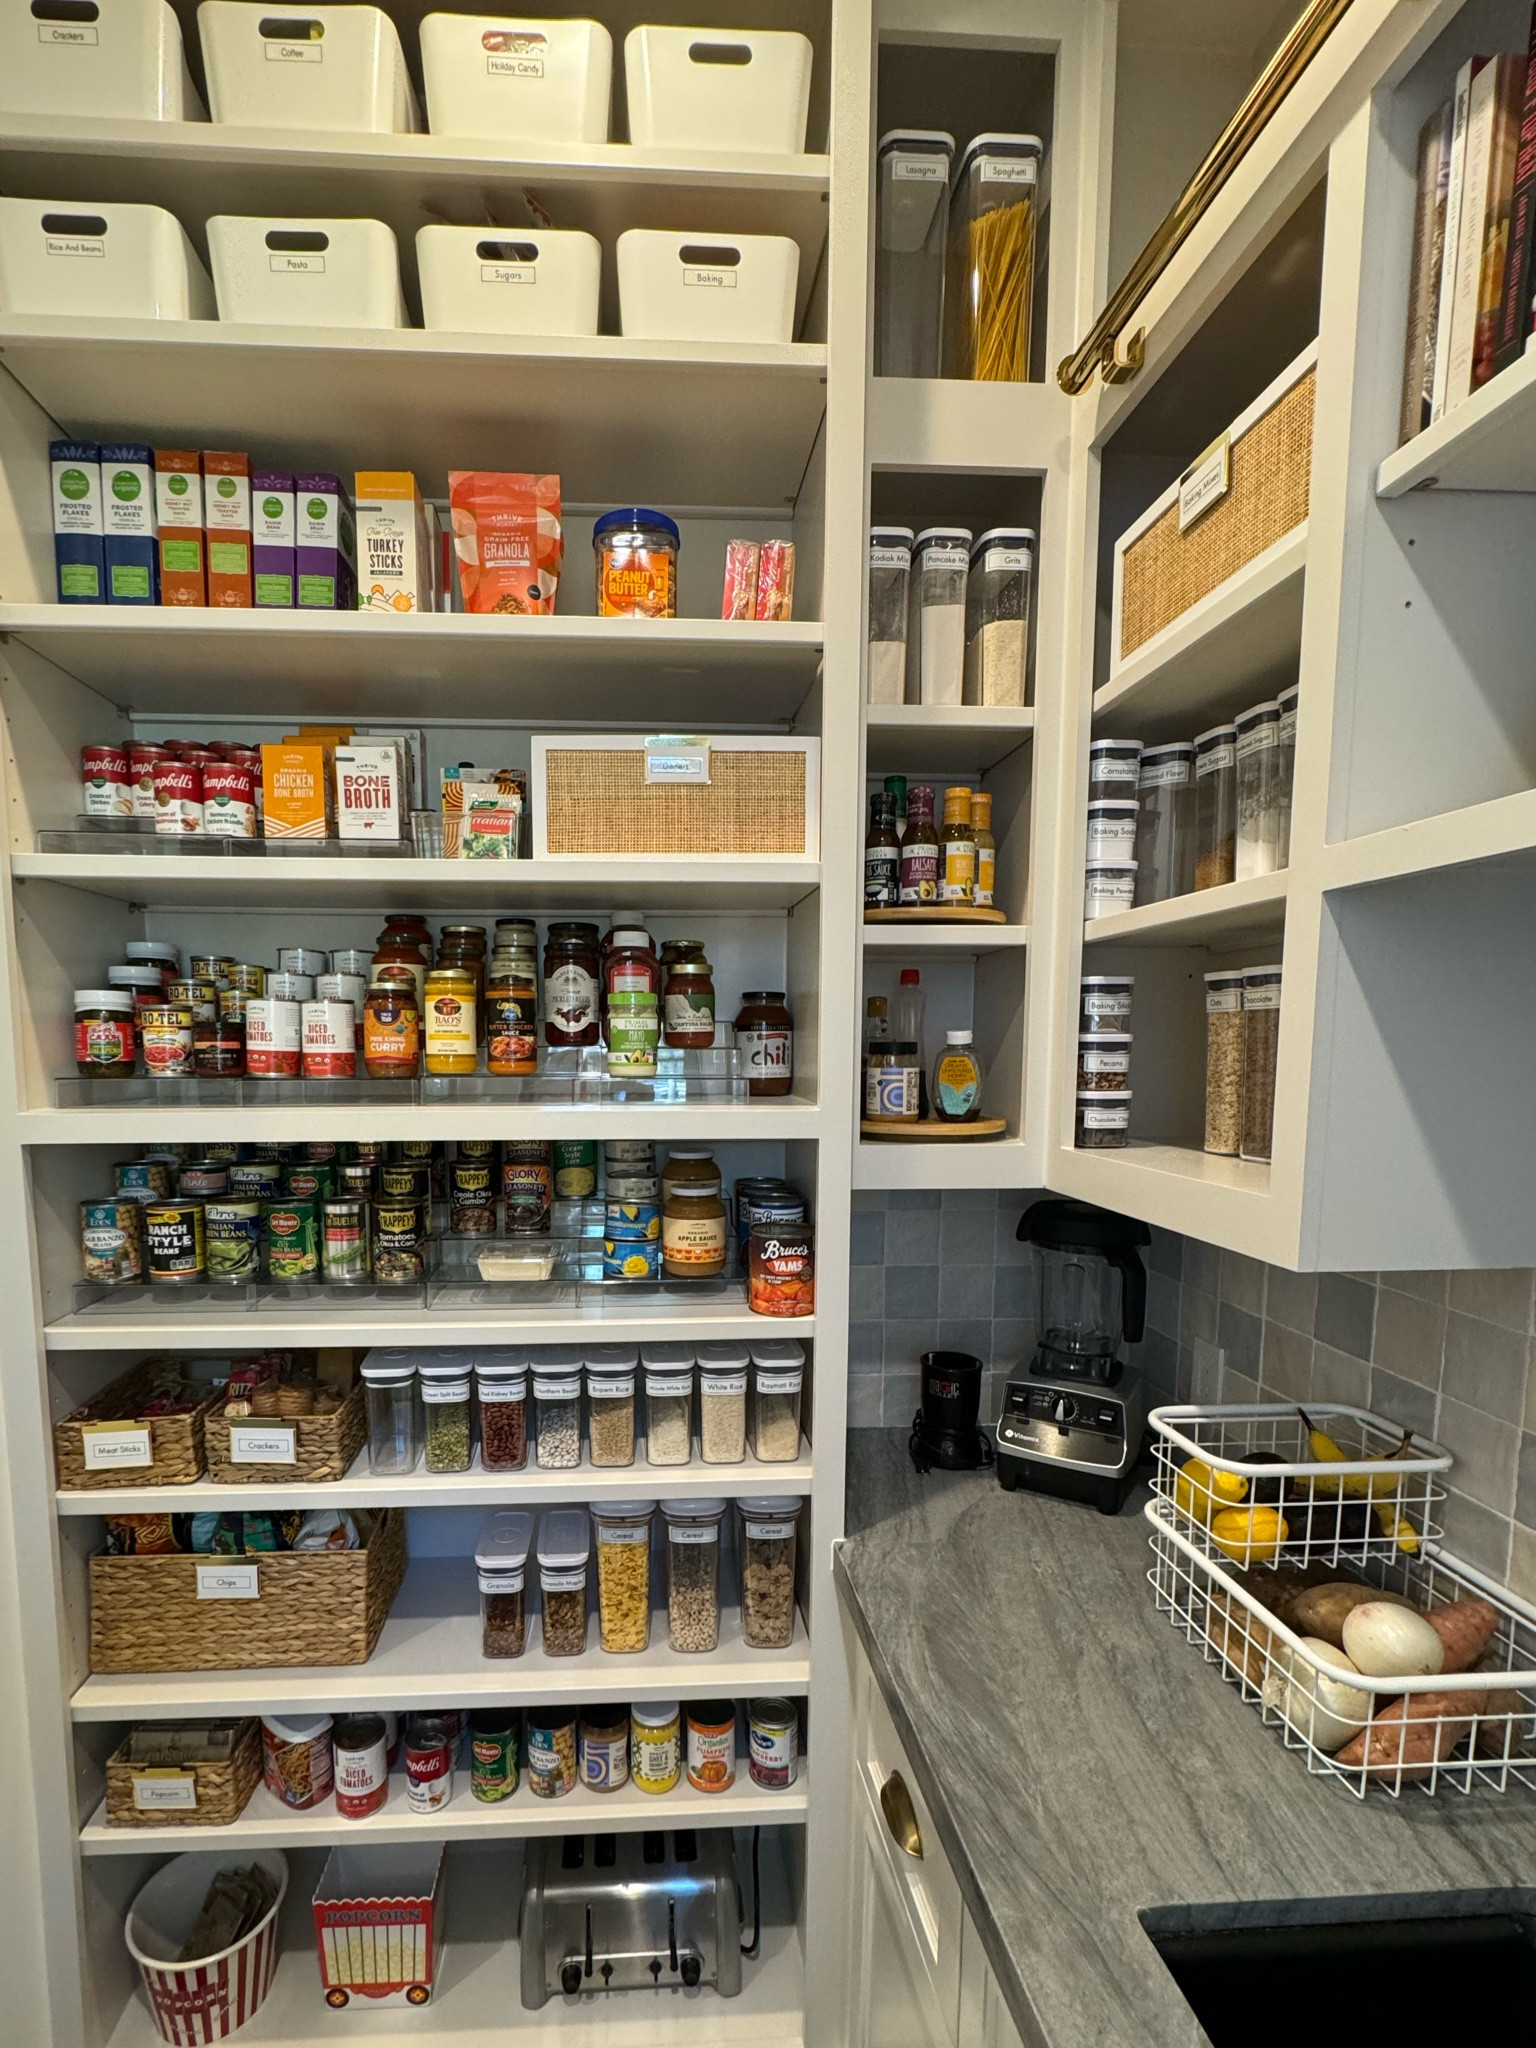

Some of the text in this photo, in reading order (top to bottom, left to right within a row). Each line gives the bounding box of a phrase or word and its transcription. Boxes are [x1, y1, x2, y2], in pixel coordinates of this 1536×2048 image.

[52, 30, 84, 42] Crackers
[281, 48, 304, 59] Coffee
[491, 61, 540, 75] Holiday Candy
[906, 166, 937, 178] Lasagna
[993, 166, 1027, 178] Spaghetti
[48, 242, 103, 254] Rice And Beans
[287, 259, 308, 270] Pasta
[495, 269, 522, 282] Sugars
[697, 273, 724, 286] Baking
[491, 513, 524, 523] THRIVE
[367, 538, 404, 554] TURKEY
[484, 543, 530, 559] GRANOLA
[370, 555, 403, 569] STICKS
[870, 552, 895, 563] Kodiak
[927, 555, 956, 566] Pancake
[1004, 556, 1021, 565] Grits
[609, 569, 651, 584] PEANUT
[609, 582, 649, 596] BUTTER
[1253, 734, 1272, 745] Sugar
[1208, 755, 1228, 767] Sugar
[1166, 769, 1185, 778] Flour
[154, 772, 193, 790] mpbell's
[273, 774, 314, 788] CHICKEN
[343, 776, 391, 788] BONE
[273, 788, 314, 798] BONE BROTH
[344, 787, 391, 809] BROTH
[224, 819, 244, 827] Noodle
[1093, 827, 1119, 838] Baking
[874, 864, 891, 876] SAUCE
[1093, 887, 1115, 896] Baking
[1091, 1001, 1115, 1011] Baking
[1210, 999, 1222, 1007] Oats
[434, 1016, 462, 1025] RAO'S
[248, 1021, 266, 1031] DICED
[307, 1024, 328, 1034] DICED
[304, 1034, 336, 1045] TOMATOES
[628, 1030, 645, 1042] MAYO
[370, 1043, 406, 1052] CURRY
[1100, 1059, 1123, 1068] Pecans
[1090, 1116, 1117, 1124] Chocolate
[564, 1151, 581, 1159] Style
[456, 1173, 490, 1186] TRAPPEY'S
[506, 1169, 541, 1181] GLORY
[123, 1178, 144, 1186] EDEN
[183, 1177, 208, 1187] Pinto
[347, 1178, 371, 1187] SUEUR
[505, 1183, 545, 1192] SEASONED
[453, 1190, 492, 1199] Creole Okra
[90, 1218, 111, 1226] EDEN
[279, 1218, 298, 1226] Monte
[332, 1216, 359, 1226] SUEUR
[379, 1212, 415, 1228] TRAPPEY'S
[149, 1225, 187, 1235] RANCH
[221, 1230, 247, 1239] BEANS
[148, 1235, 192, 1247] STYLE
[760, 1240, 809, 1260] Bruce's
[772, 1260, 803, 1271] YAMS
[228, 1382, 252, 1397] RITZ
[615, 1385, 630, 1393] Rice
[707, 1383, 727, 1391] White
[761, 1381, 800, 1389] Basmati Rice
[440, 1391, 451, 1399] Split
[490, 1389, 524, 1399] Kidney Beans
[1014, 1432, 1039, 1443] Vitamix
[98, 1445, 141, 1455] Meat Sticks
[247, 1442, 280, 1451] Crackers
[611, 1531, 634, 1540] Cereal
[682, 1531, 703, 1540] Cereal
[760, 1527, 782, 1535] Cereal
[216, 1578, 237, 1588] Chips
[486, 1581, 515, 1590] Granola
[542, 1577, 583, 1587] Granola Maple
[531, 1738, 549, 1749] EDEN
[696, 1746, 731, 1755] PUMPKIN
[406, 1757, 440, 1773] mpbell's
[345, 1768, 366, 1779] DICED
[340, 1775, 373, 1787] TOMATOES
[150, 1790, 180, 1799] Popcorn
[325, 1909, 423, 1924] POPCORN
[156, 1986, 229, 2008] POPCORN
